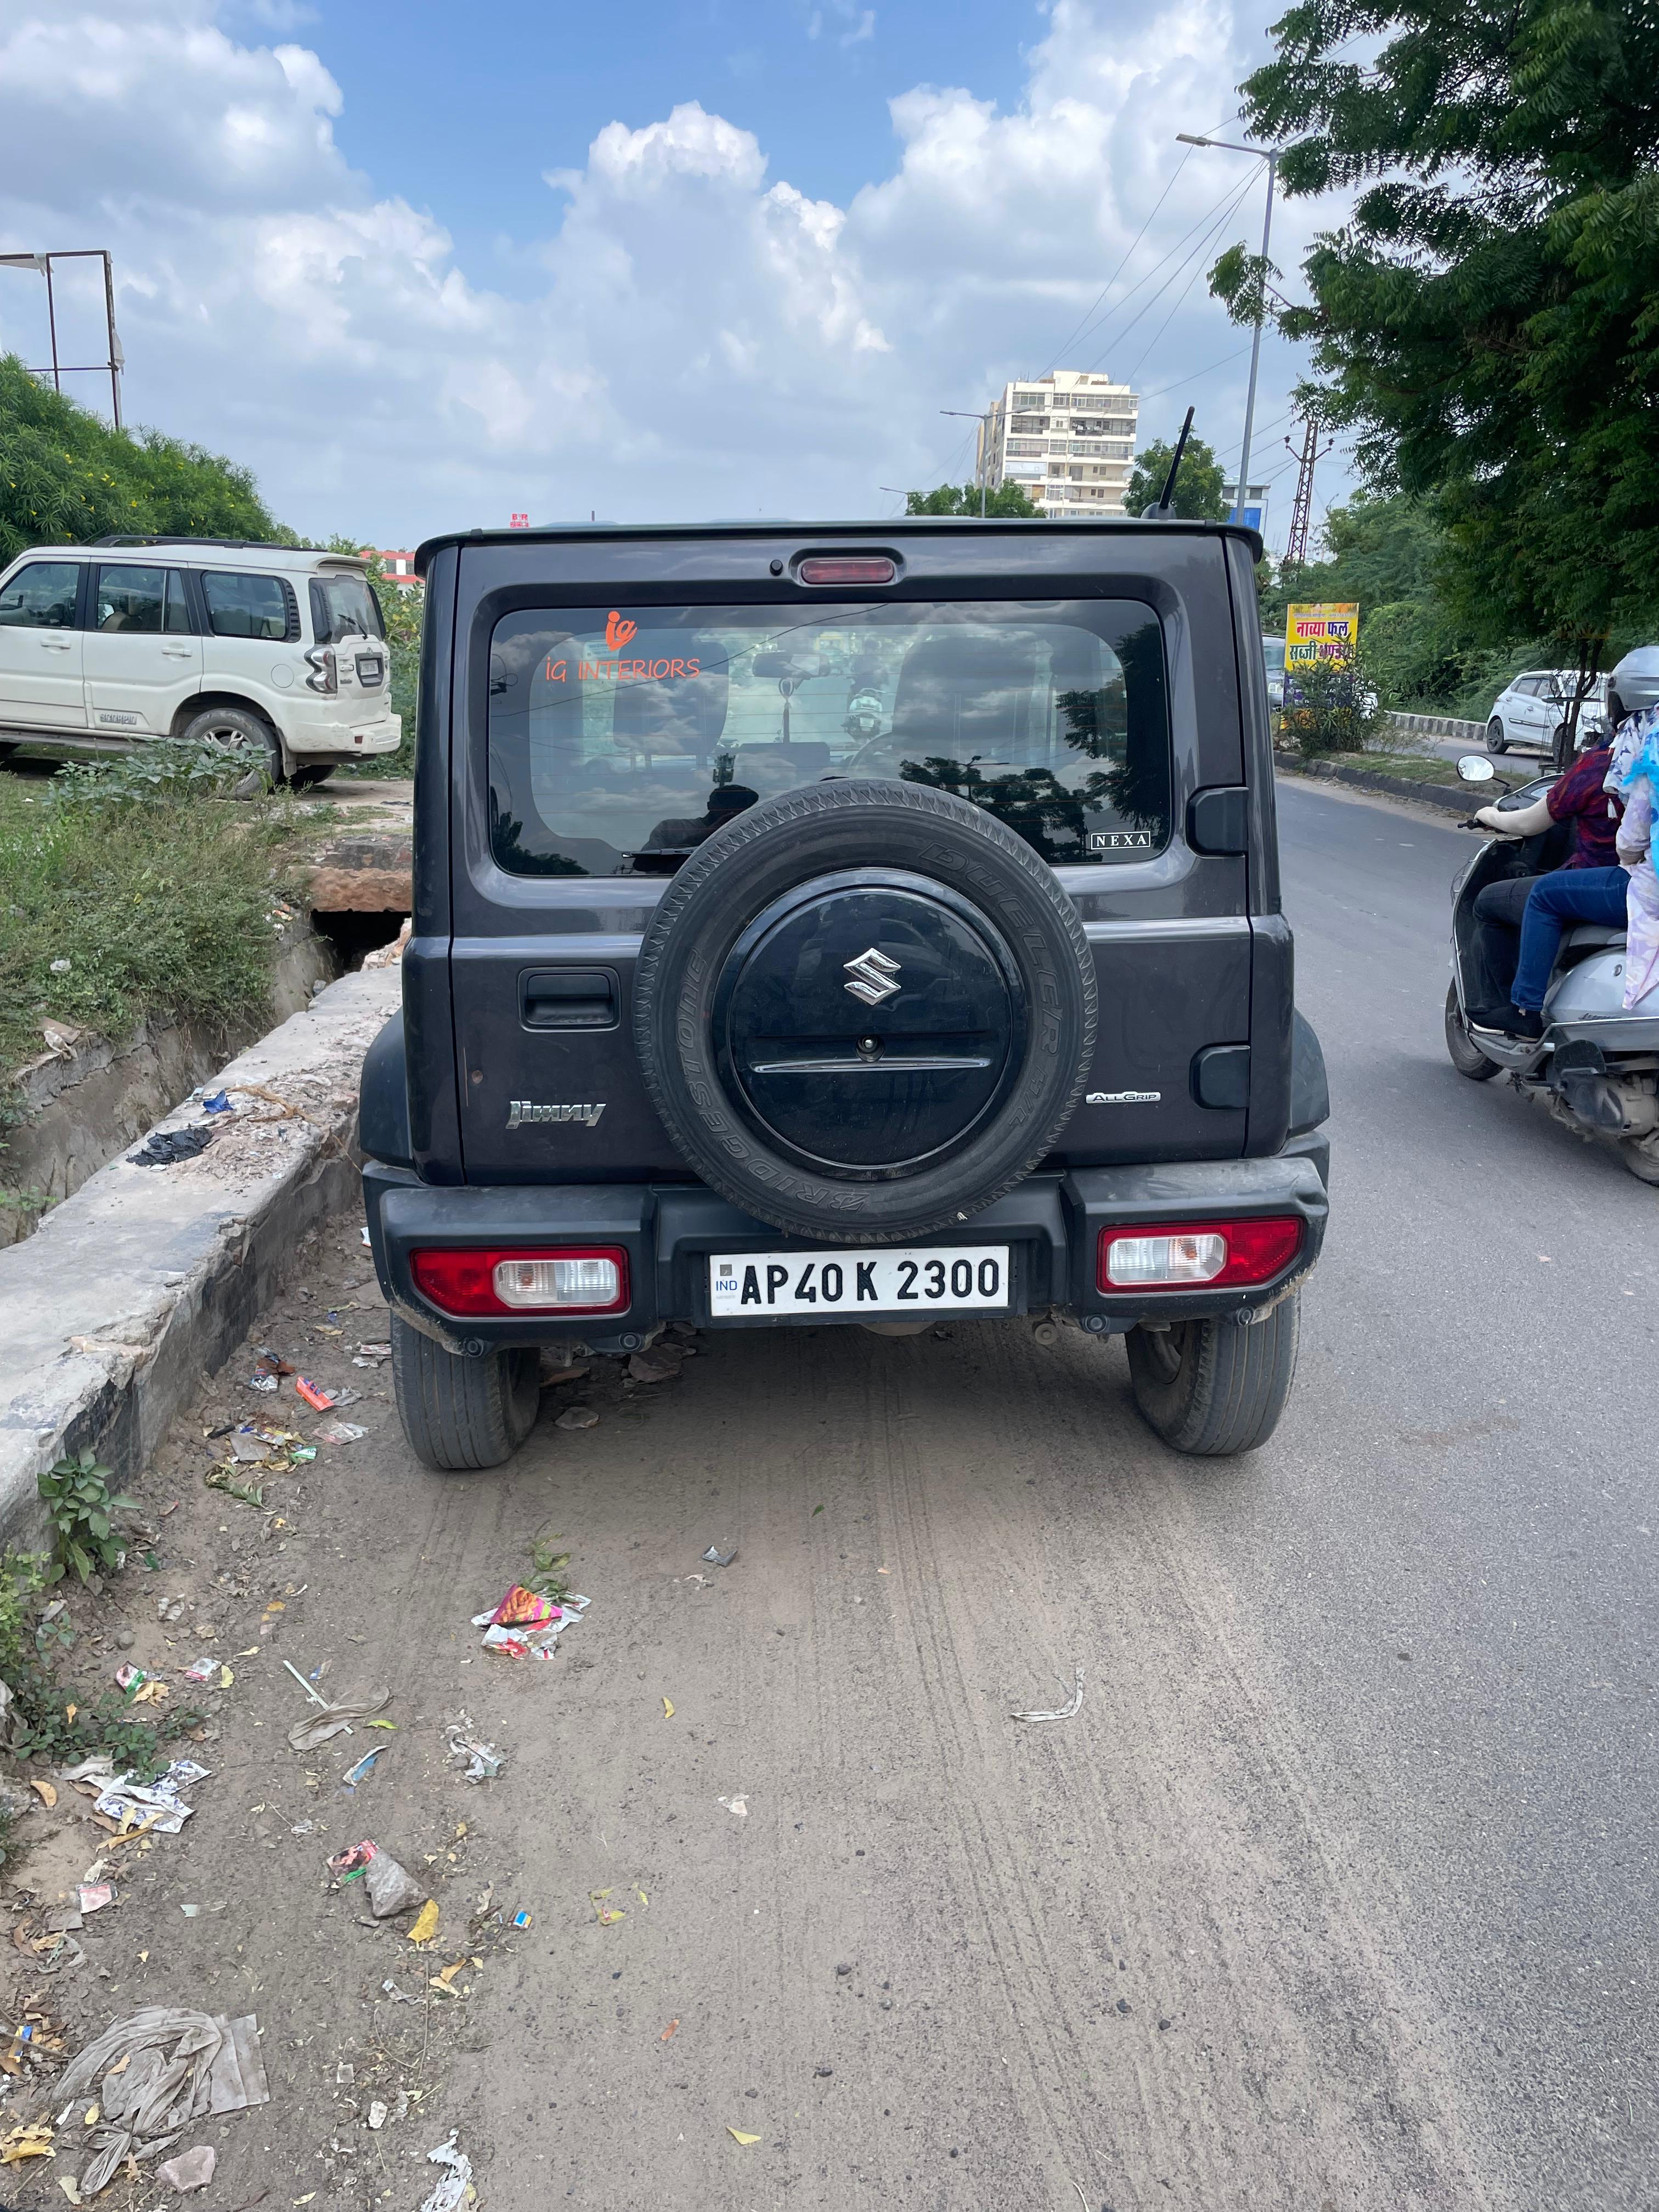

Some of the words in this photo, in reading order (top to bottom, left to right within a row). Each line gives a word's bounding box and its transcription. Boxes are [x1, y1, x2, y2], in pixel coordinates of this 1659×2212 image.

[1296, 622, 1325, 637] नाव्या
[1328, 622, 1348, 636] फल
[579, 658, 700, 680] INTERIORS
[1096, 834, 1147, 847] NEXA
[676, 948, 870, 1212] BRIDGESTONE
[505, 1101, 606, 1129] Jimny
[716, 1280, 737, 1291] IND
[741, 1263, 843, 1305] AP40
[857, 1261, 878, 1301] K
[897, 1259, 1000, 1300] 2300
